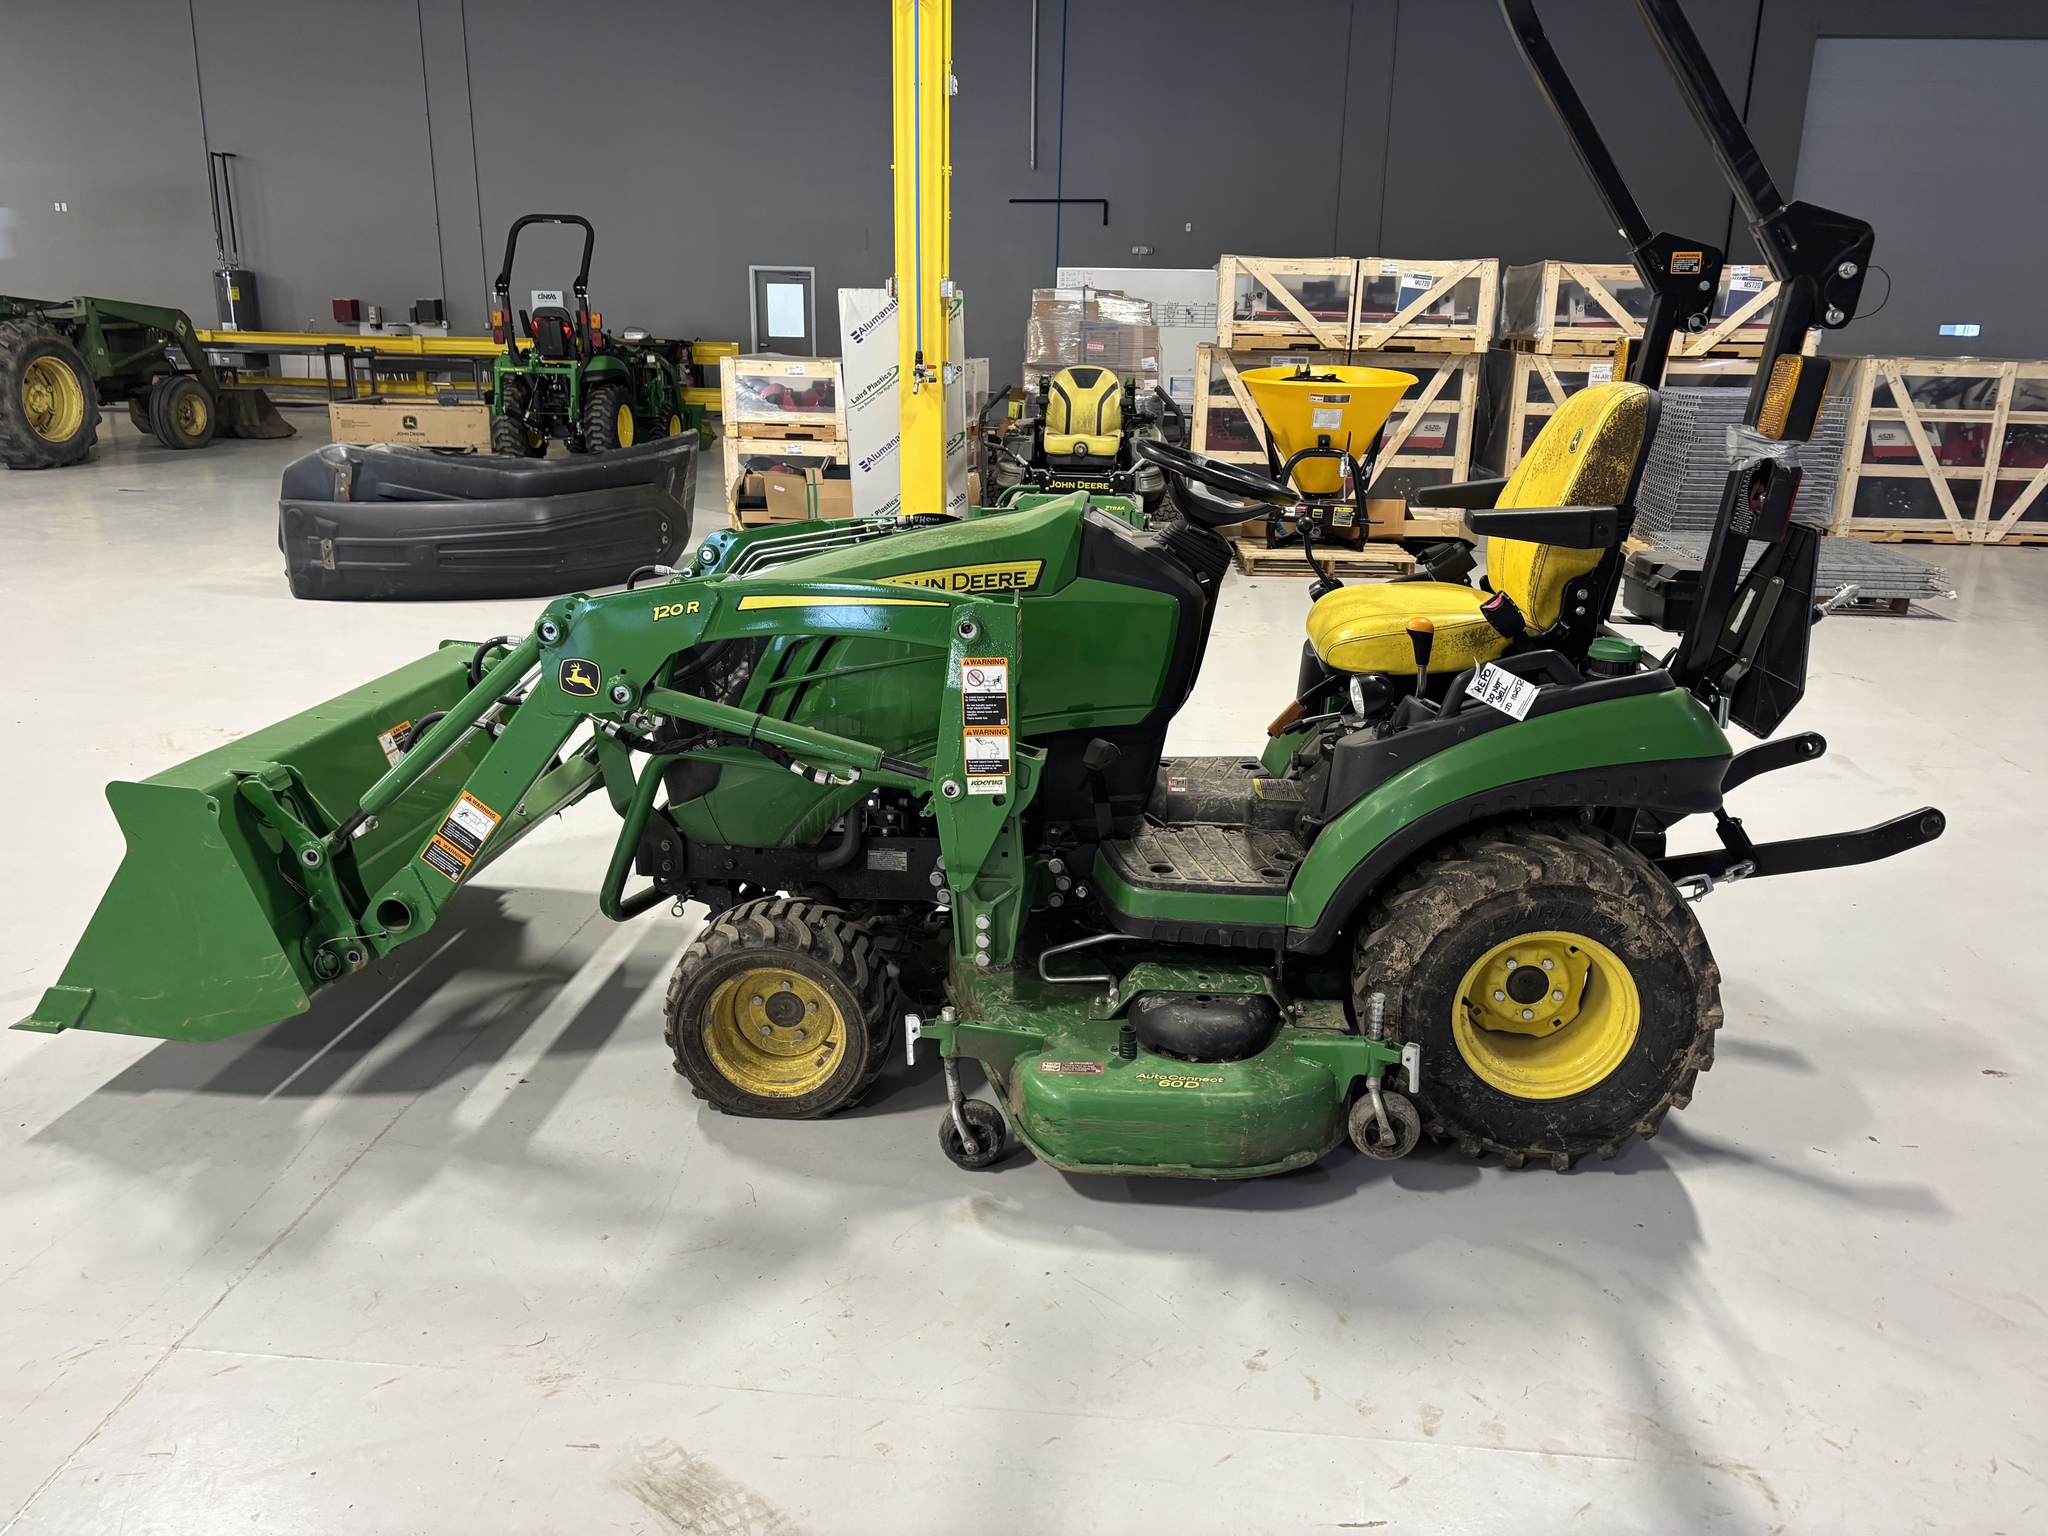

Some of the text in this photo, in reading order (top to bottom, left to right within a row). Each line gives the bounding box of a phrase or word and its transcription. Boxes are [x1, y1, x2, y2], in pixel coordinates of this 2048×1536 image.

[851, 371, 893, 404] Laird Plastics
[866, 432, 901, 464] Alumana
[1049, 480, 1110, 490] JOHN DEERE
[952, 571, 1027, 591] DEERE
[653, 603, 684, 621] 120
[970, 658, 1005, 666] WARNING
[1473, 668, 1491, 694] REPO
[1495, 685, 1509, 703] SELL
[973, 728, 1007, 736] WARNING
[472, 799, 497, 820] WARNING
[443, 843, 467, 863] WARNING
[1492, 905, 1632, 937] CARLISL
[1135, 1072, 1225, 1084] AutoConnect
[1157, 1080, 1201, 1089] 60D
